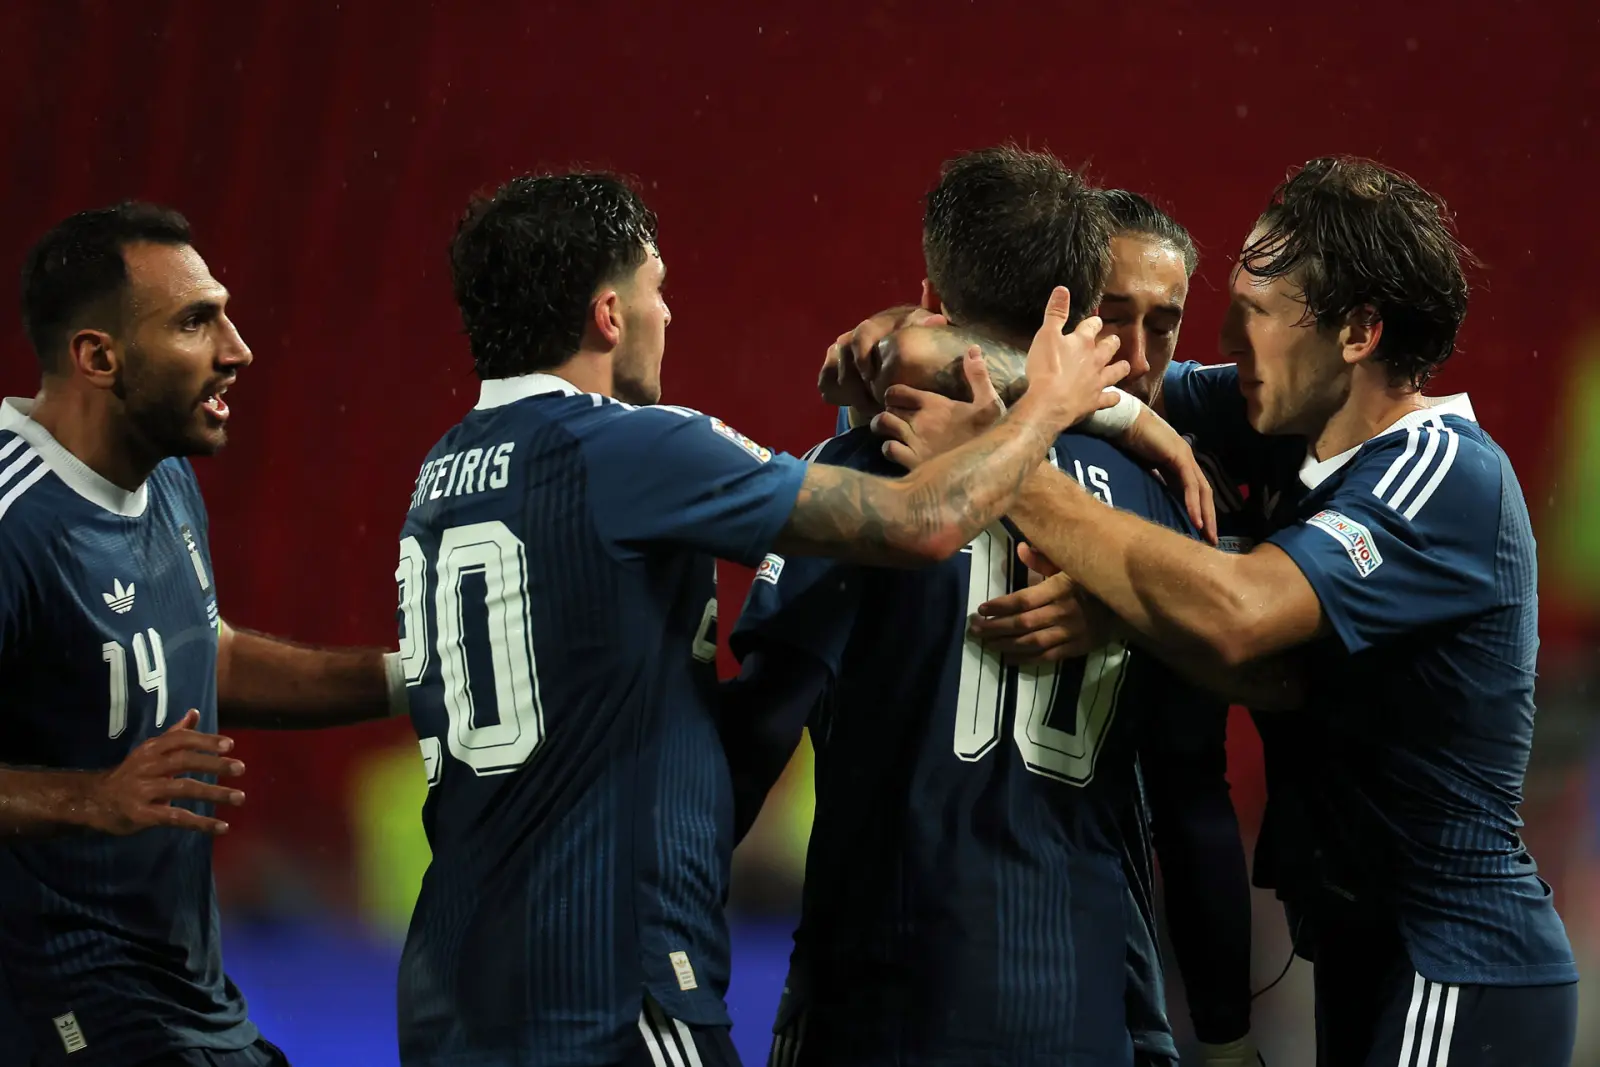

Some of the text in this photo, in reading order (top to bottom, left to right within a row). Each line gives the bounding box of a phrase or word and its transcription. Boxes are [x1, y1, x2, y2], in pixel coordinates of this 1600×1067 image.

[1315, 512, 1376, 571] FOUNDATION
[102, 627, 168, 739] 14
[954, 521, 1131, 788] 10
